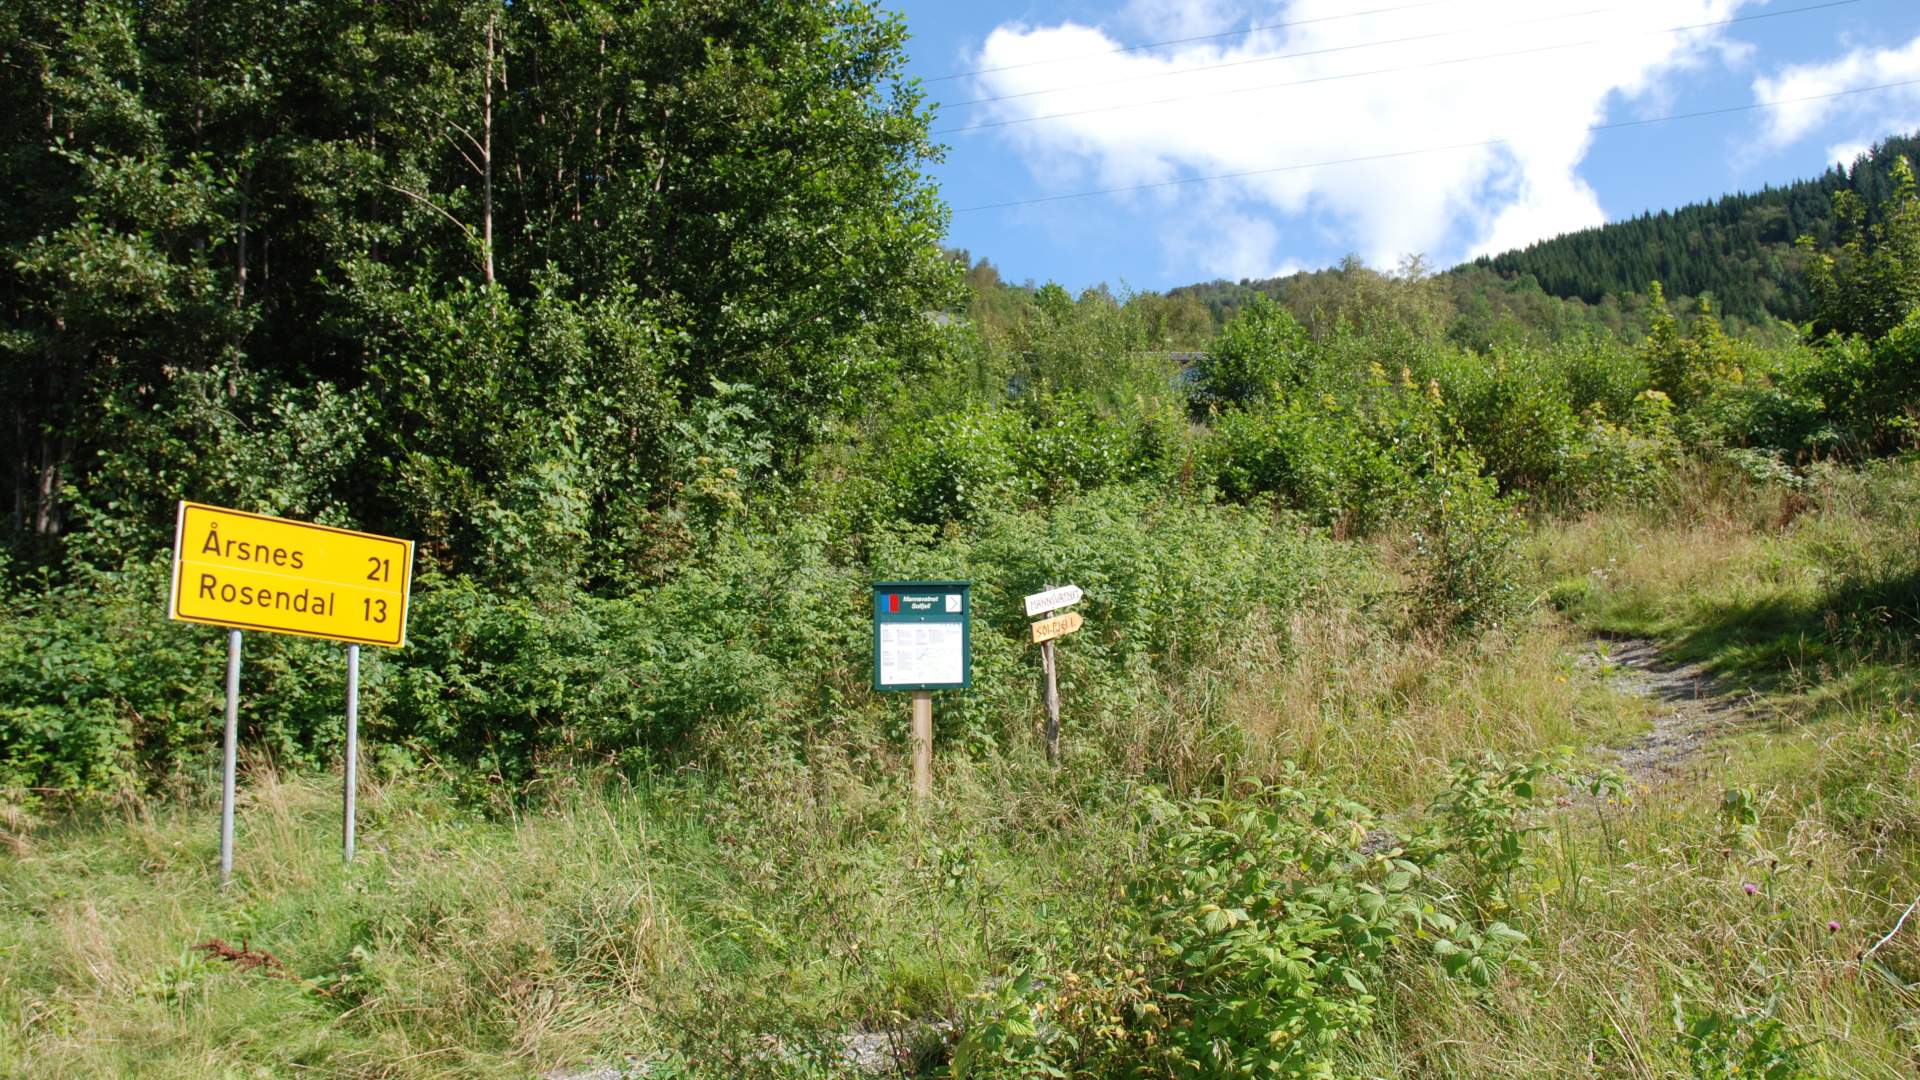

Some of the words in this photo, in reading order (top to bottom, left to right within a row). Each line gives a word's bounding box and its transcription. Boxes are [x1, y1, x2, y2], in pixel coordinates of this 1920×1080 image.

[202, 521, 304, 569] Årsnes
[366, 556, 390, 582] 21
[199, 573, 334, 617] Rosendal
[364, 598, 387, 623] 13
